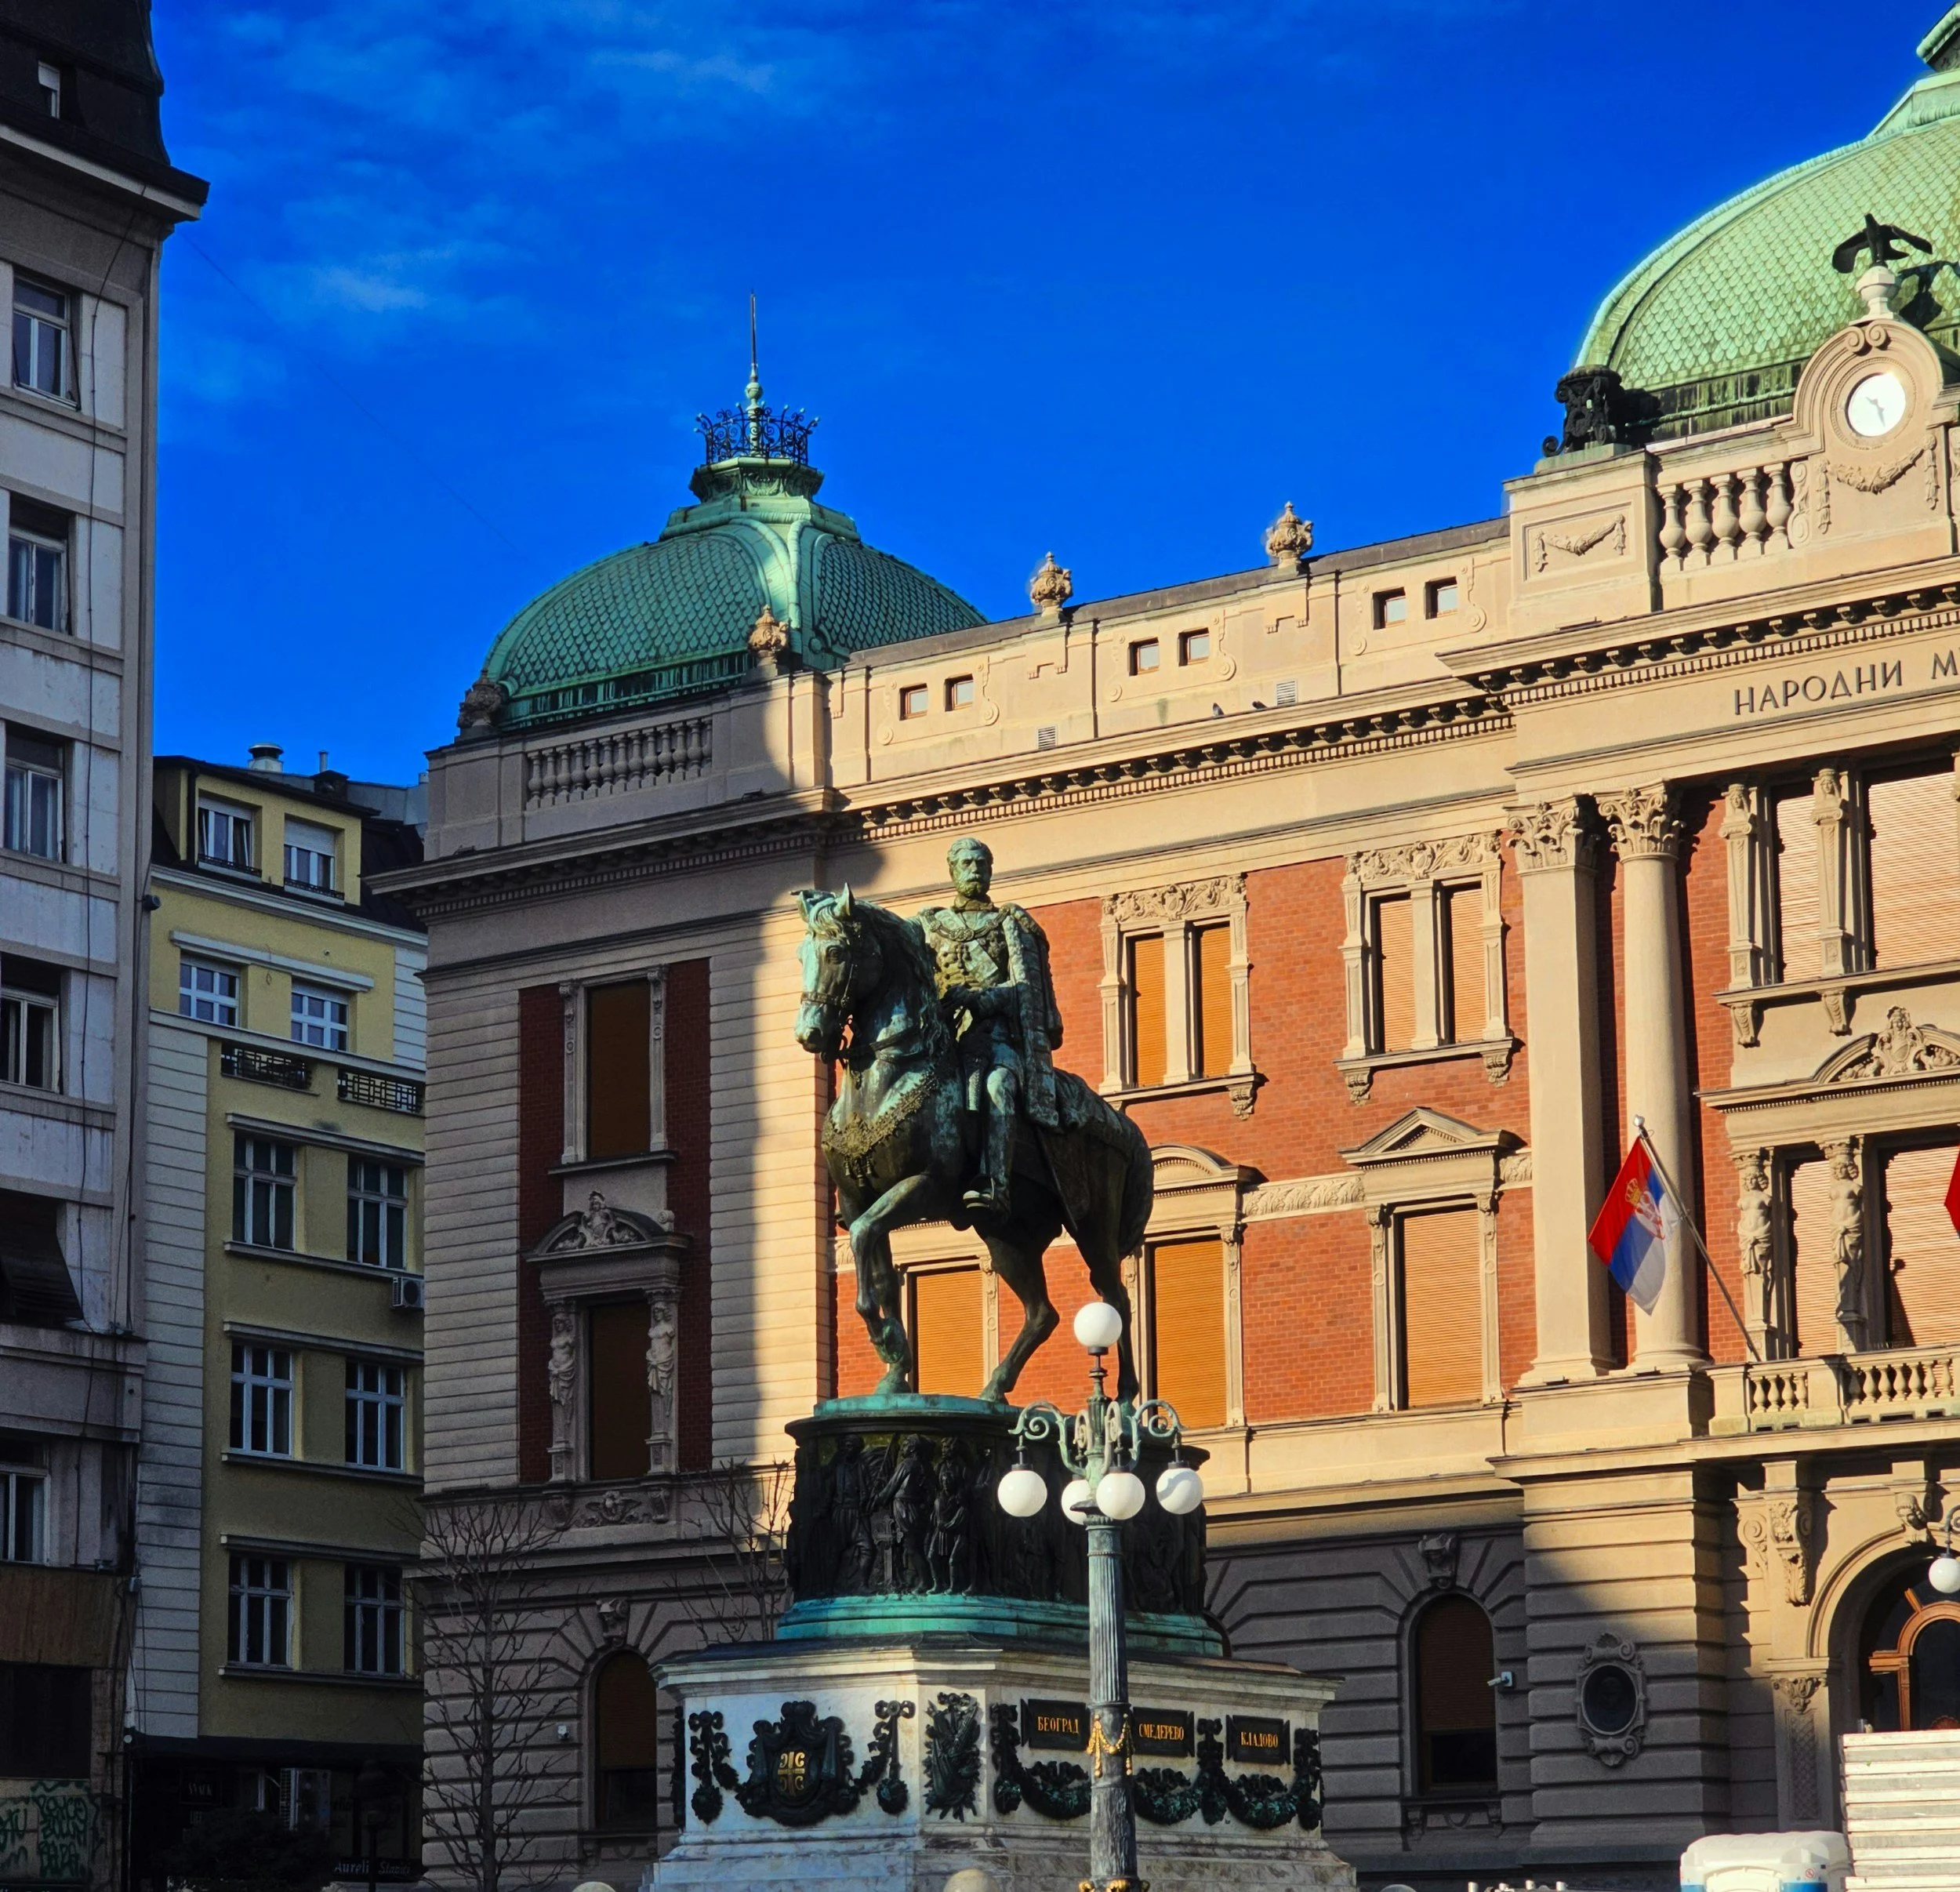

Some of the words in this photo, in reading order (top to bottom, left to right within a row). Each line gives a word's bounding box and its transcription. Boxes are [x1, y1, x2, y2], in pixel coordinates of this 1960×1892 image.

[1734, 659, 1903, 715] НАРОДНИ
[1931, 647, 1960, 680] М
[1037, 1716, 1080, 1734] БЕОГРАД
[1138, 1723, 1185, 1741] СМЕДЕРЕВО
[1240, 1730, 1279, 1749] КЛАДОВО
